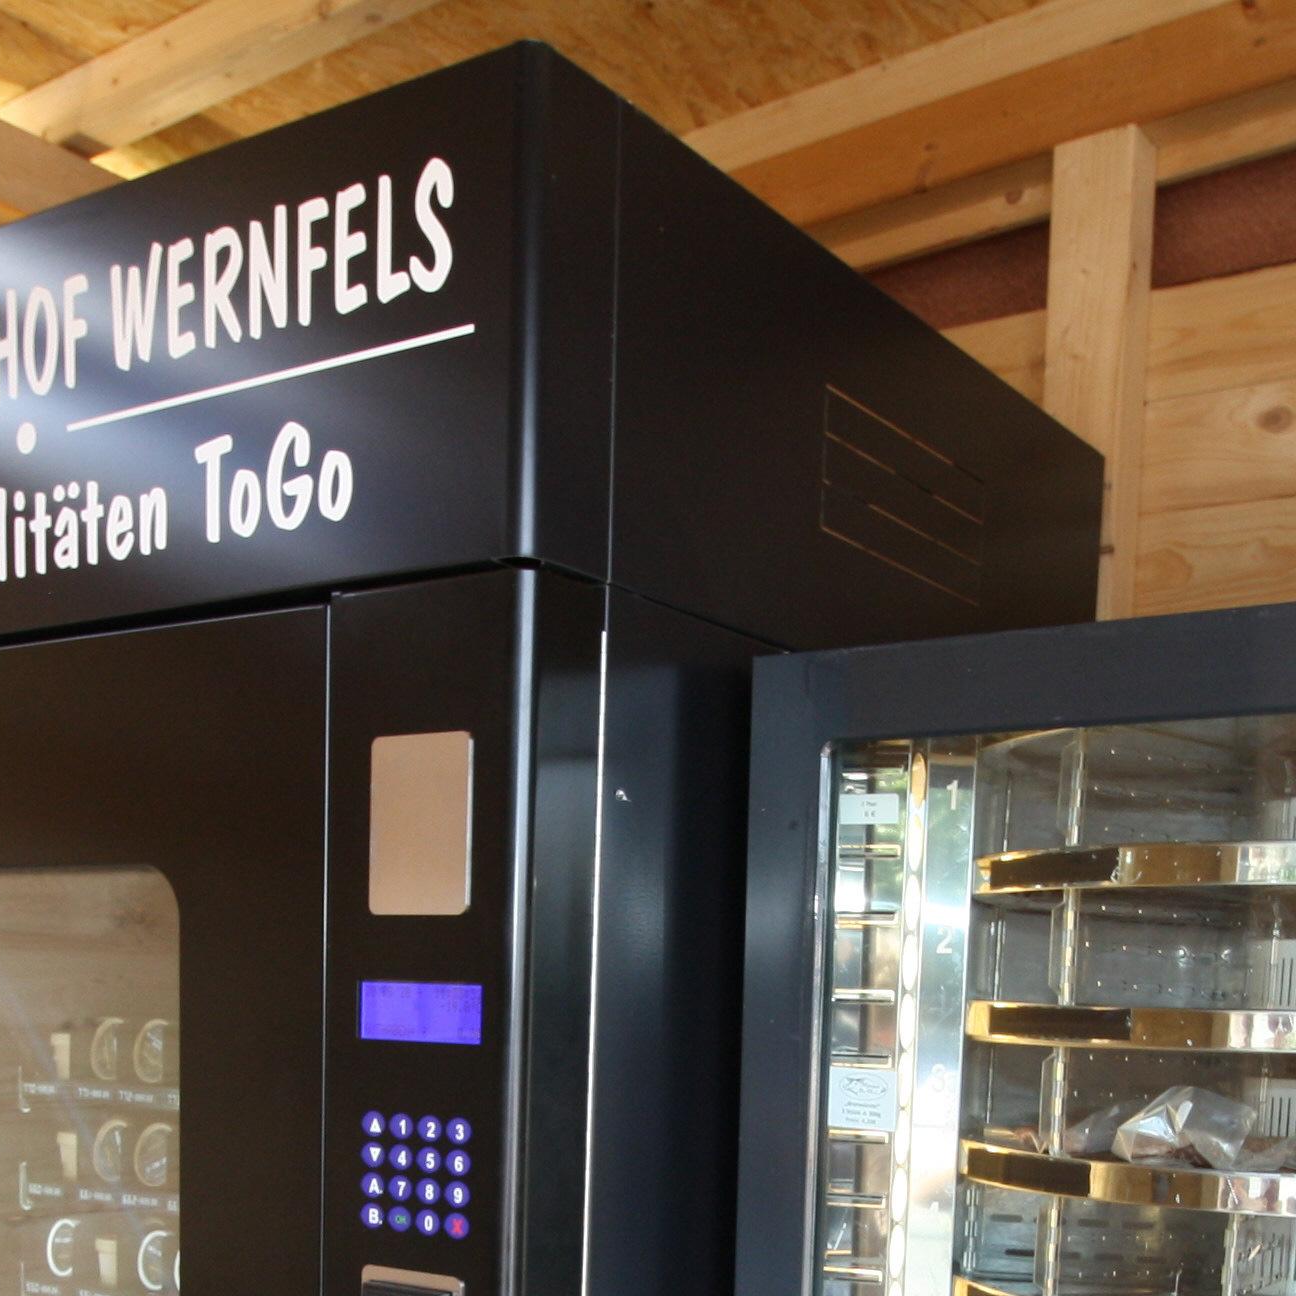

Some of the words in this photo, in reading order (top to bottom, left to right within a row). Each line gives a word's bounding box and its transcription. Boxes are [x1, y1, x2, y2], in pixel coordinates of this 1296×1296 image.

[110, 157, 455, 372] WERNFELS
[195, 420, 355, 544] ToGo
[946, 780, 960, 811] 1
[936, 926, 953, 955] 2
[399, 1119, 406, 1135] 1
[426, 1121, 436, 1138] 2
[455, 1123, 464, 1141] 3
[397, 1150, 406, 1166] 4
[425, 1152, 435, 1169] 5
[454, 1155, 464, 1173] 6
[397, 1181, 406, 1197] 7
[424, 1183, 434, 1200] 8
[453, 1187, 463, 1204] 9
[424, 1215, 434, 1231] 0
